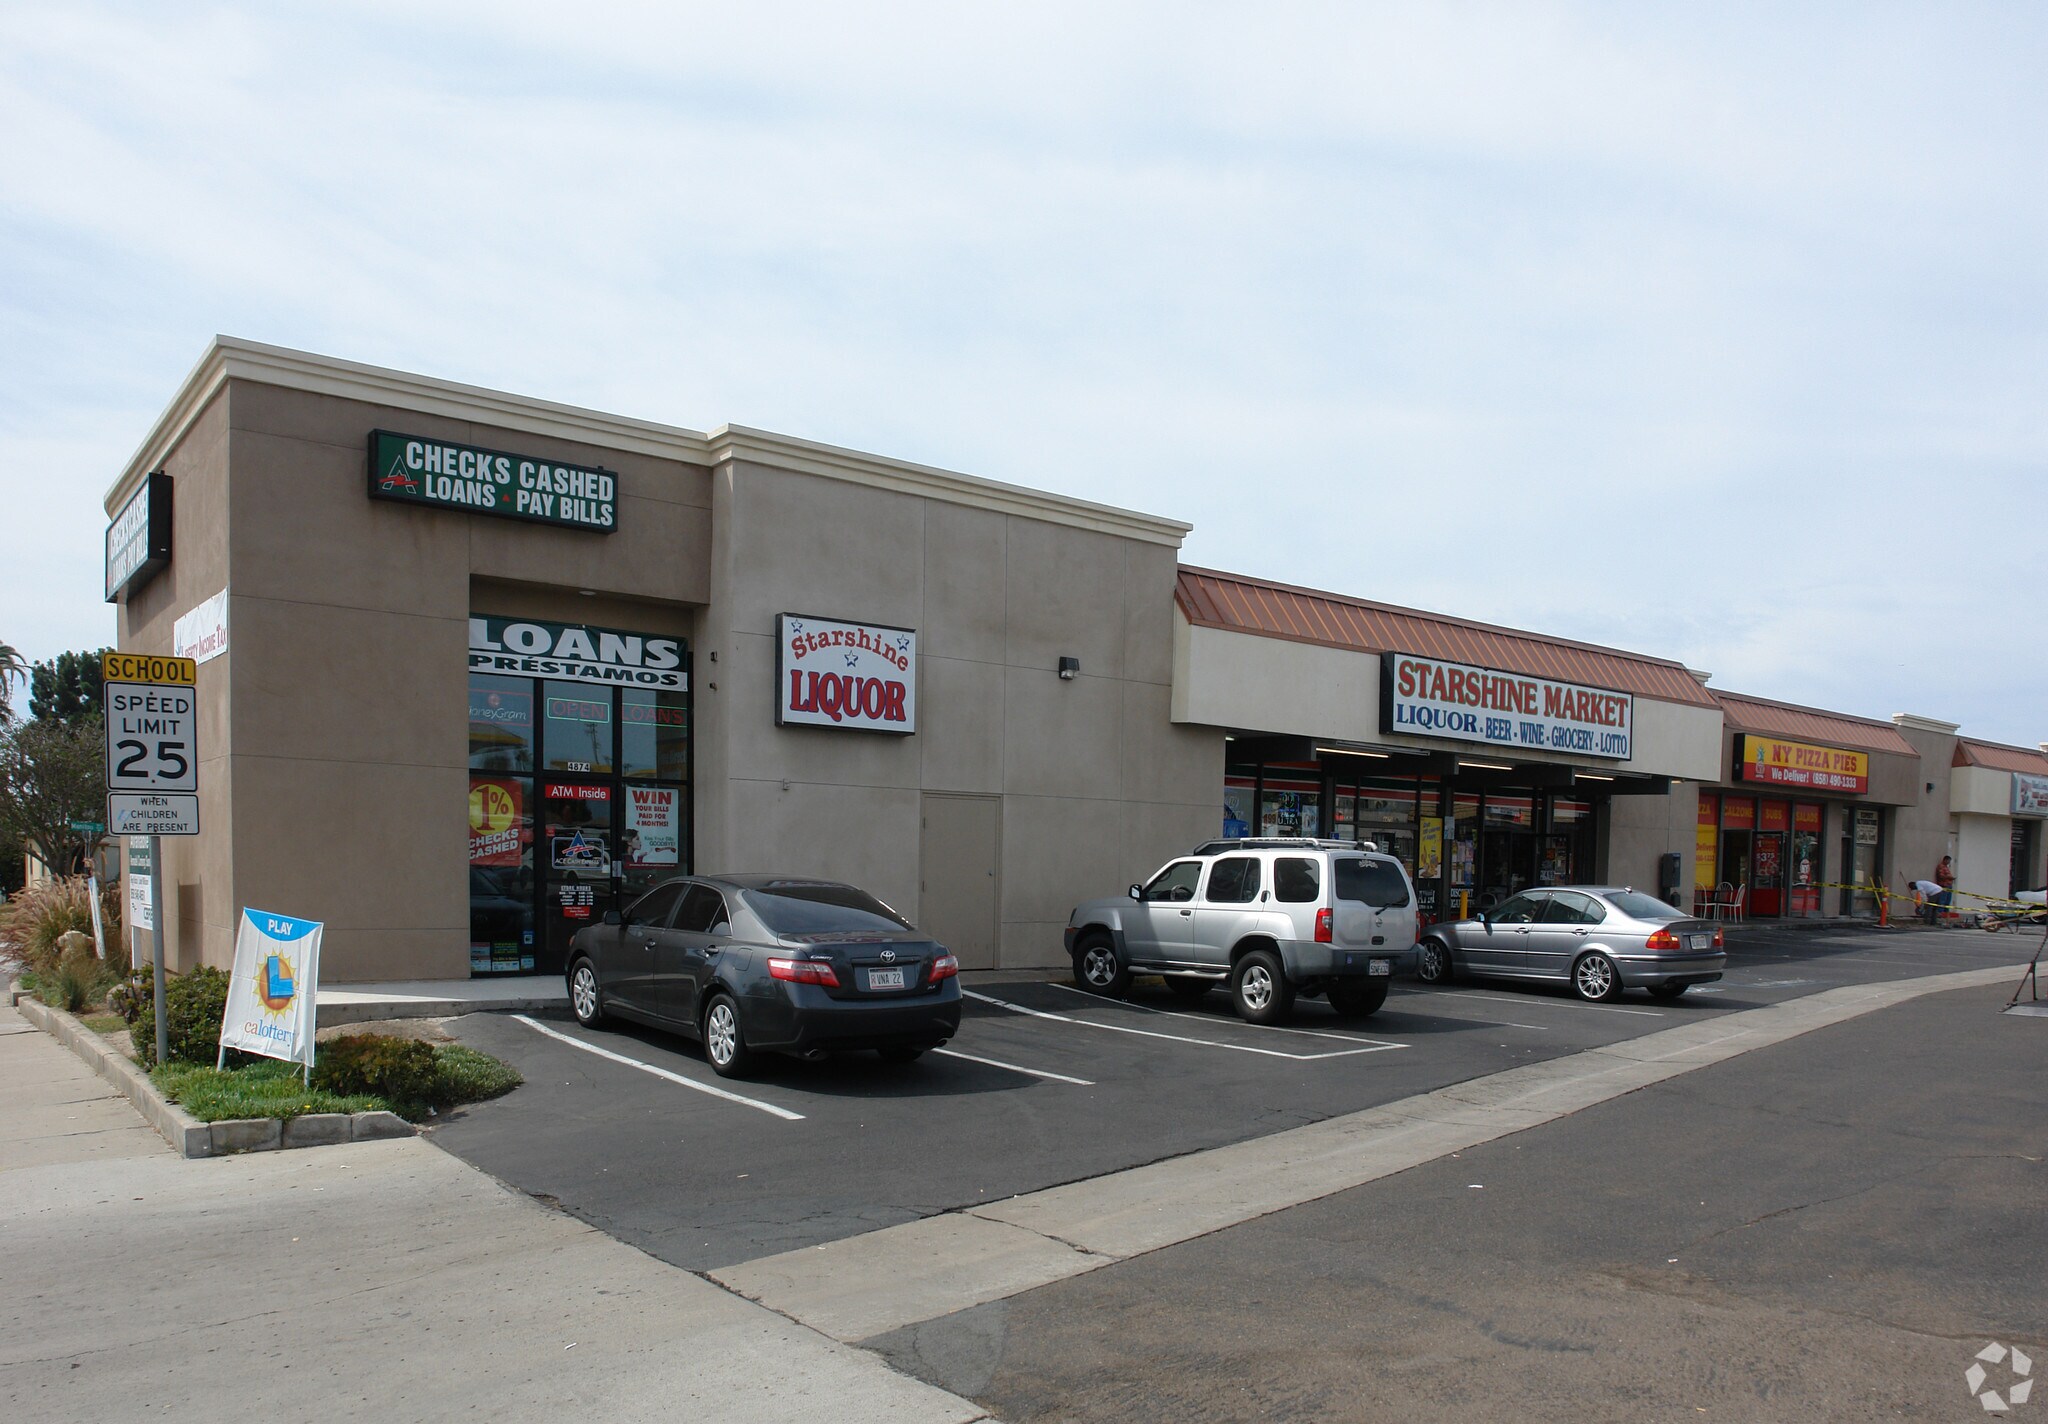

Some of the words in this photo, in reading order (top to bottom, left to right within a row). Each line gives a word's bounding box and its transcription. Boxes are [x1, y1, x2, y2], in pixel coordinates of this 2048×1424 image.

[406, 441, 511, 485] CHECKS
[518, 461, 614, 502] CASHED
[425, 474, 496, 508] LOANS
[516, 489, 554, 517] PAY
[560, 496, 613, 526] BILLS
[469, 618, 680, 670] LOANS
[791, 628, 909, 672] Starshine
[108, 658, 193, 682] SCHOOL
[790, 669, 907, 722] LIQUOR
[1397, 659, 1538, 716] STARSHINE
[1543, 684, 1628, 728] MARKET
[114, 695, 189, 714] SPEED
[551, 700, 605, 719] OPEN
[622, 704, 685, 725] LOANS
[123, 718, 181, 735] LIMIT
[1396, 703, 1477, 733] LIQUOR
[1485, 717, 1512, 741] BEER
[1519, 721, 1544, 745] WINE
[1551, 725, 1594, 751] GROCERY
[1600, 732, 1627, 755] LOTTO
[116, 740, 188, 779] 25
[568, 762, 590, 772] 4874
[1772, 744, 1793, 763] NY
[1795, 747, 1829, 769] PIZZA
[1833, 753, 1857, 772] PIES
[1771, 767, 1782, 780] We
[1783, 769, 1809, 783] Deliver!
[1812, 772, 1829, 785] (858)
[1829, 775, 1857, 789] 490-1333
[140, 797, 168, 806] WHEN
[551, 786, 573, 797] ATM
[578, 787, 606, 799] Inside
[632, 790, 672, 805] WIN
[130, 809, 178, 819] CHILDREN
[476, 786, 509, 831] 1%
[1724, 806, 1754, 818] CALZONE
[1765, 808, 1783, 820] SUBS
[1795, 810, 1818, 823] SALADS
[122, 822, 142, 831] ARE
[147, 823, 189, 832] PRESENT
[469, 828, 519, 848] CHECKS
[469, 840, 519, 860] CASHED
[268, 918, 294, 936] PLAY
[877, 973, 890, 984] VNA
[893, 972, 901, 984] 22
[244, 1019, 296, 1043] calottery
